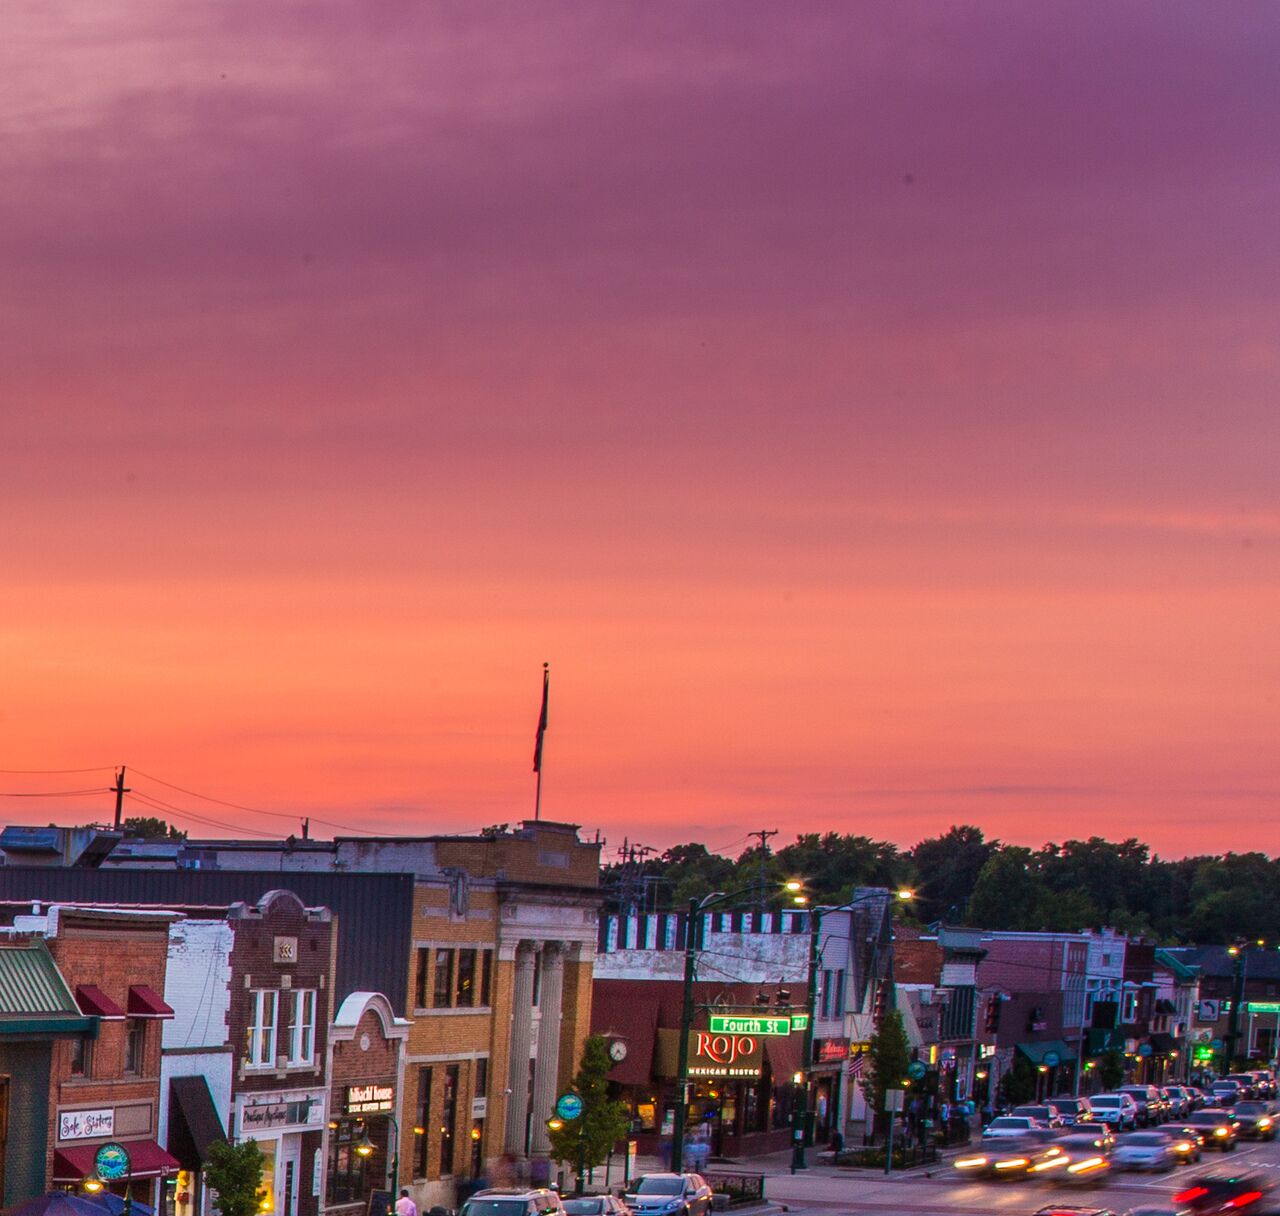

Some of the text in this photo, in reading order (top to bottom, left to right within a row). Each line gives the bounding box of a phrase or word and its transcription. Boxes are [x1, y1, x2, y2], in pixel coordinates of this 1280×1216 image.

[723, 1020, 778, 1033] Fourth St
[696, 1032, 757, 1064] ROJO
[729, 1068, 759, 1076] BISTRO
[85, 1114, 112, 1135] Sisters
